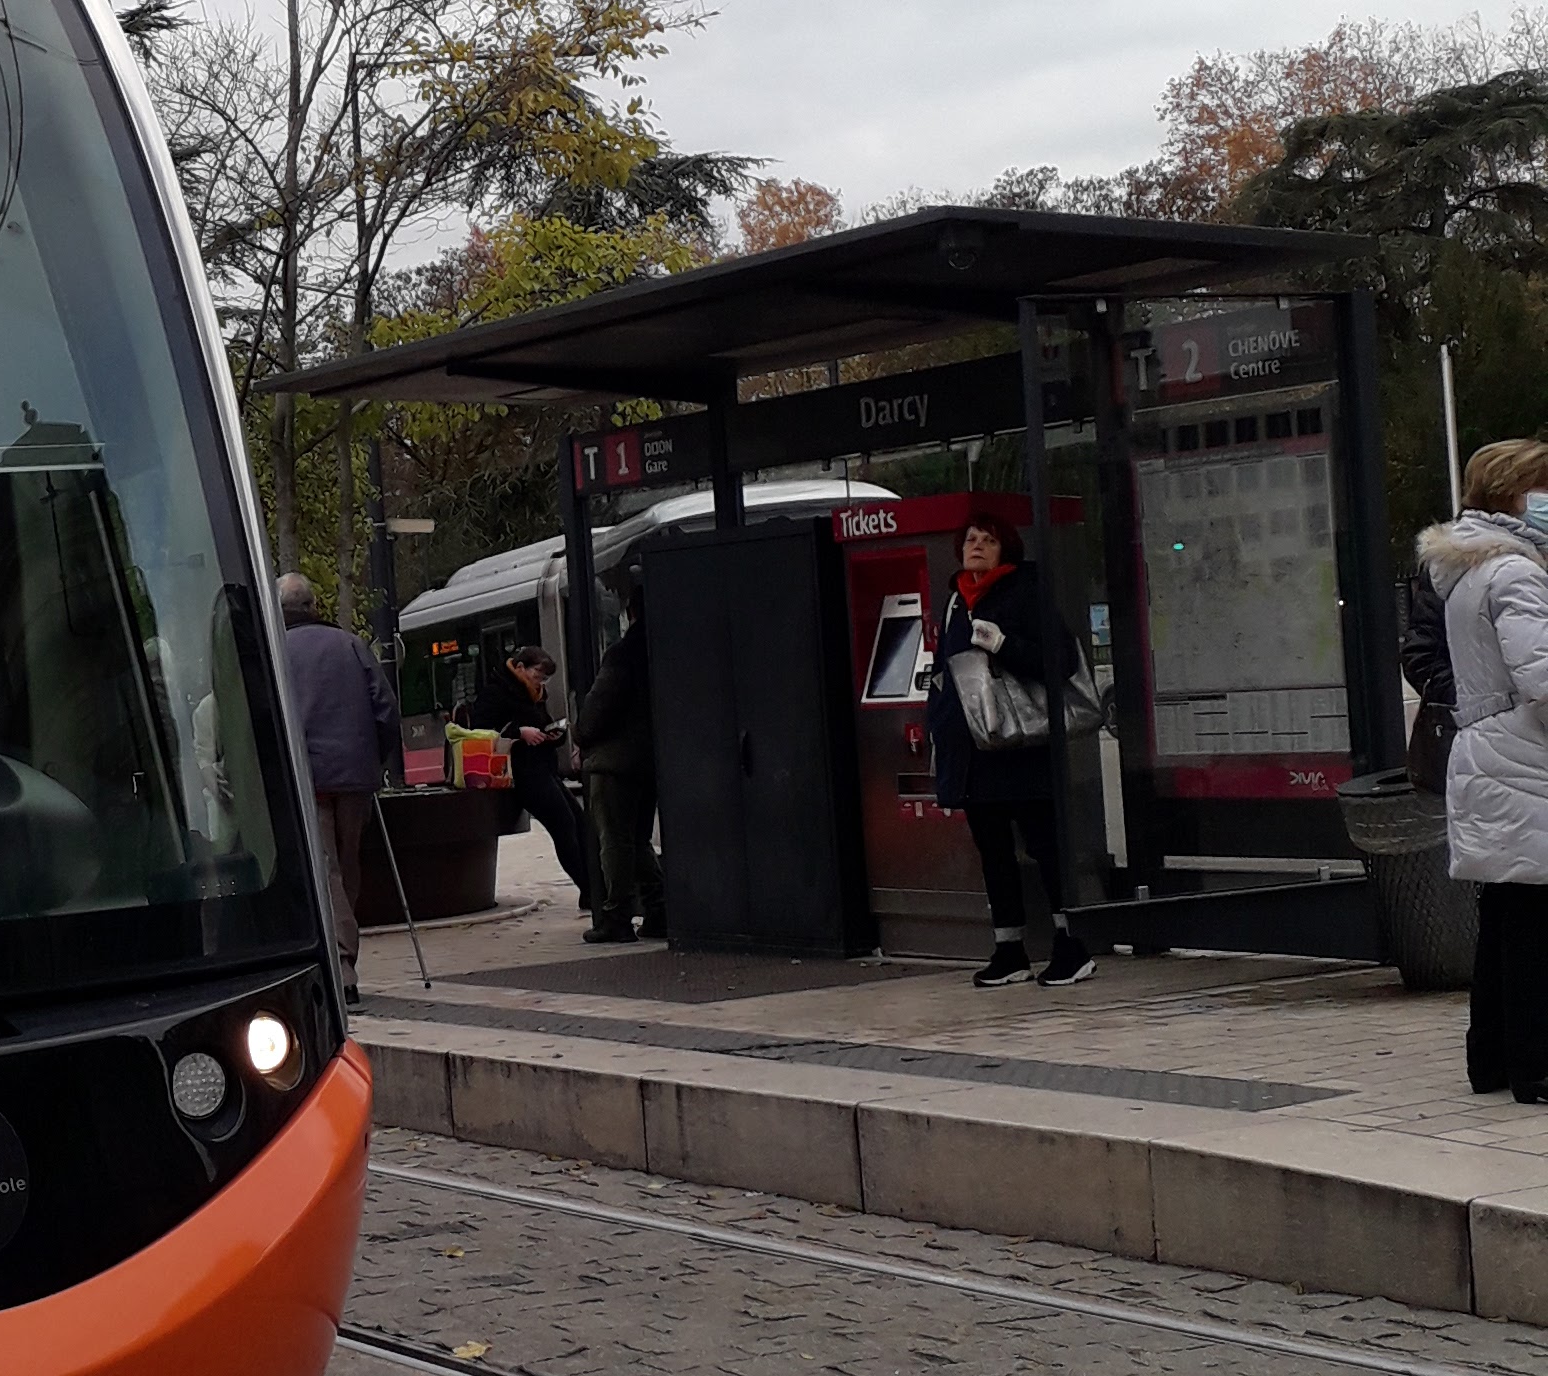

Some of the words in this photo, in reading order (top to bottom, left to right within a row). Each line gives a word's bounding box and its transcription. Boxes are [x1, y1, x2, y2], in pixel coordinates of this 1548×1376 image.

[1130, 347, 1156, 391] T
[1182, 339, 1203, 384] 2
[1230, 358, 1281, 380] Centre
[859, 393, 929, 428] Darcy
[583, 446, 599, 480] T
[616, 441, 630, 475] 1
[645, 459, 669, 474] Gare
[839, 508, 898, 538] Tickets
